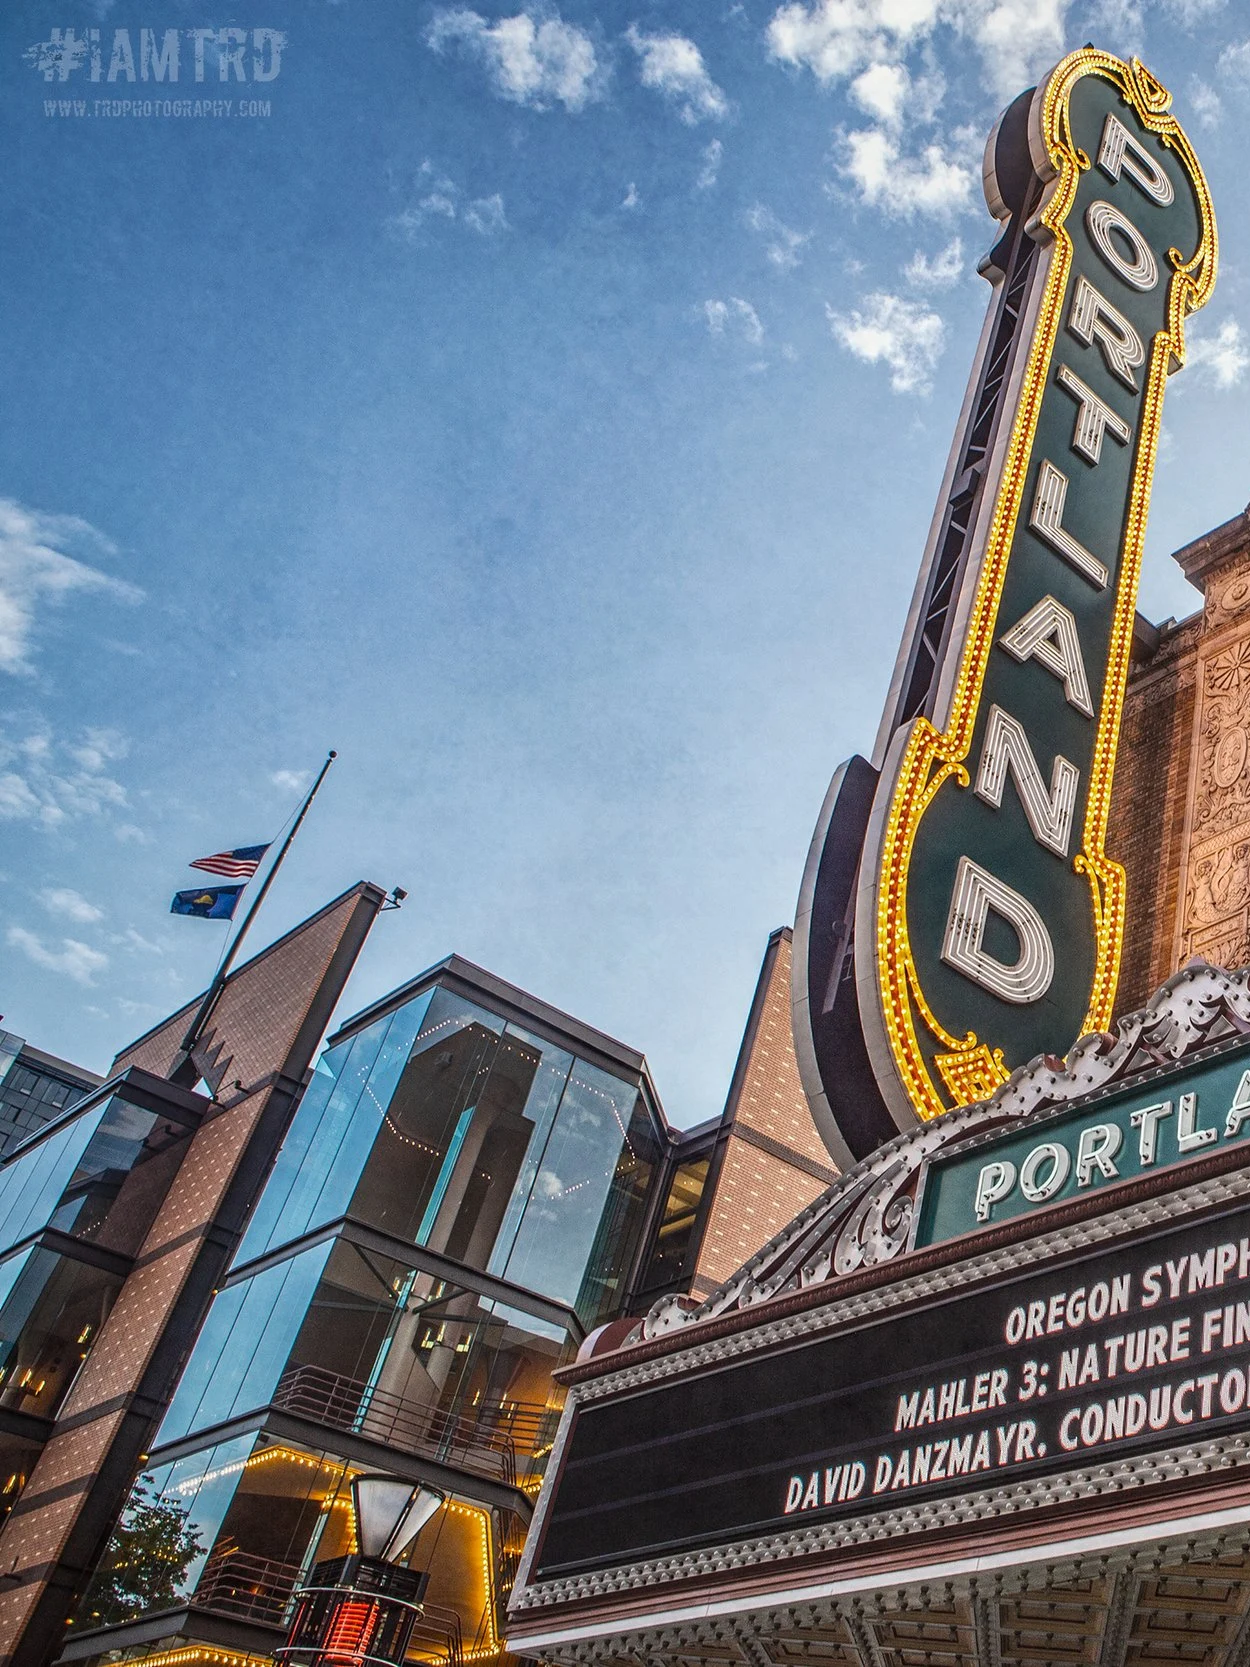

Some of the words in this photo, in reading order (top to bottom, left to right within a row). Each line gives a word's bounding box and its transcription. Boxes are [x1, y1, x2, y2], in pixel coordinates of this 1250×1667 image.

[941, 111, 1175, 1004] PORTLAND
[1005, 1273, 1132, 1346] OREGON
[893, 1367, 1009, 1433] MAHLER
[1018, 1359, 1049, 1402] 3:
[1057, 1317, 1191, 1390] NATURE
[784, 1460, 866, 1514] DAVID
